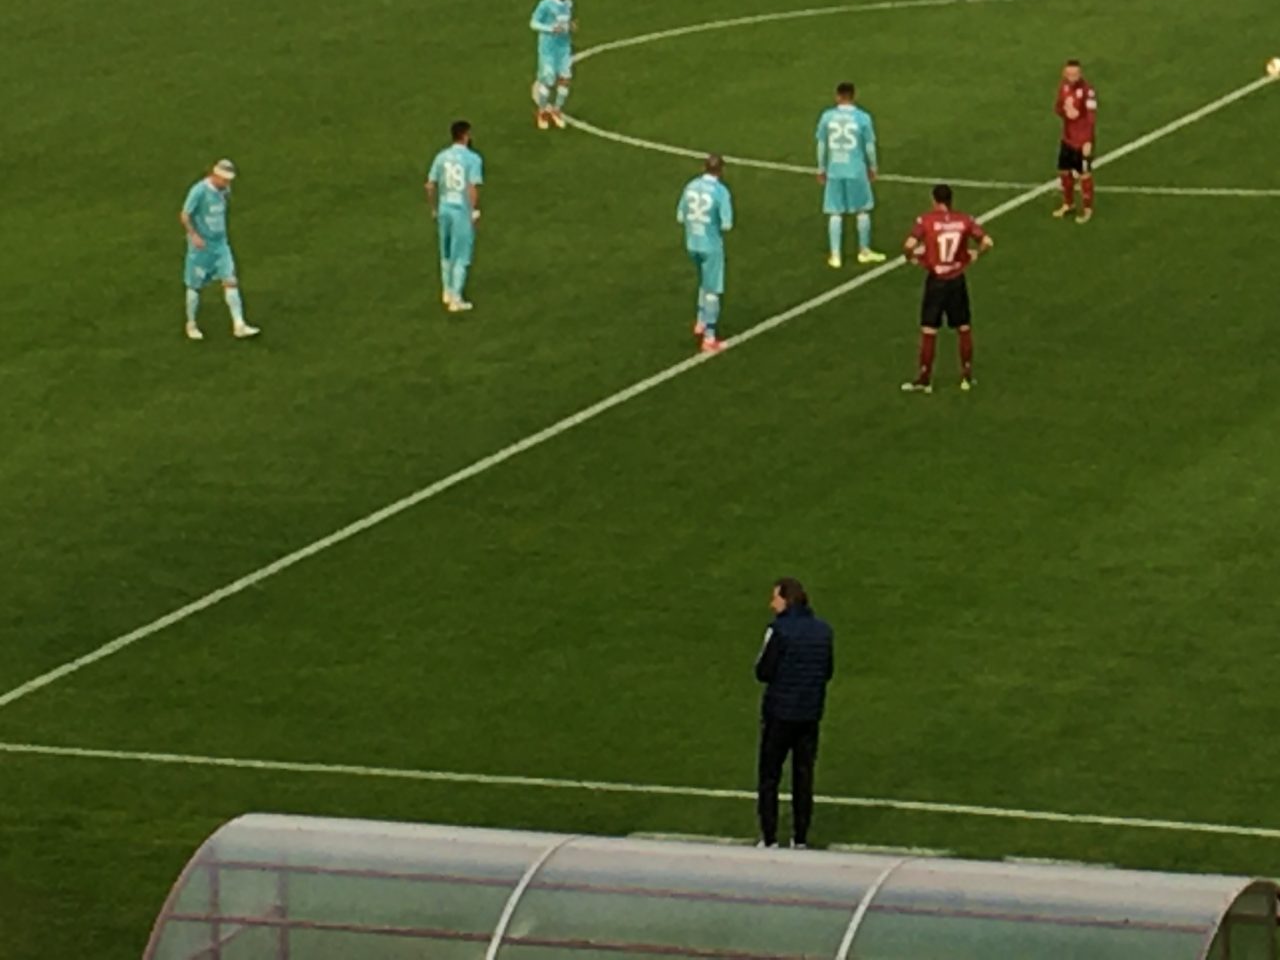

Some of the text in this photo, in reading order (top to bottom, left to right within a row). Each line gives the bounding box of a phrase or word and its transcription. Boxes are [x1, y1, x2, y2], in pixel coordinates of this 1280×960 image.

[827, 121, 859, 150] 25
[685, 189, 714, 224] 32
[936, 230, 962, 263] 17
